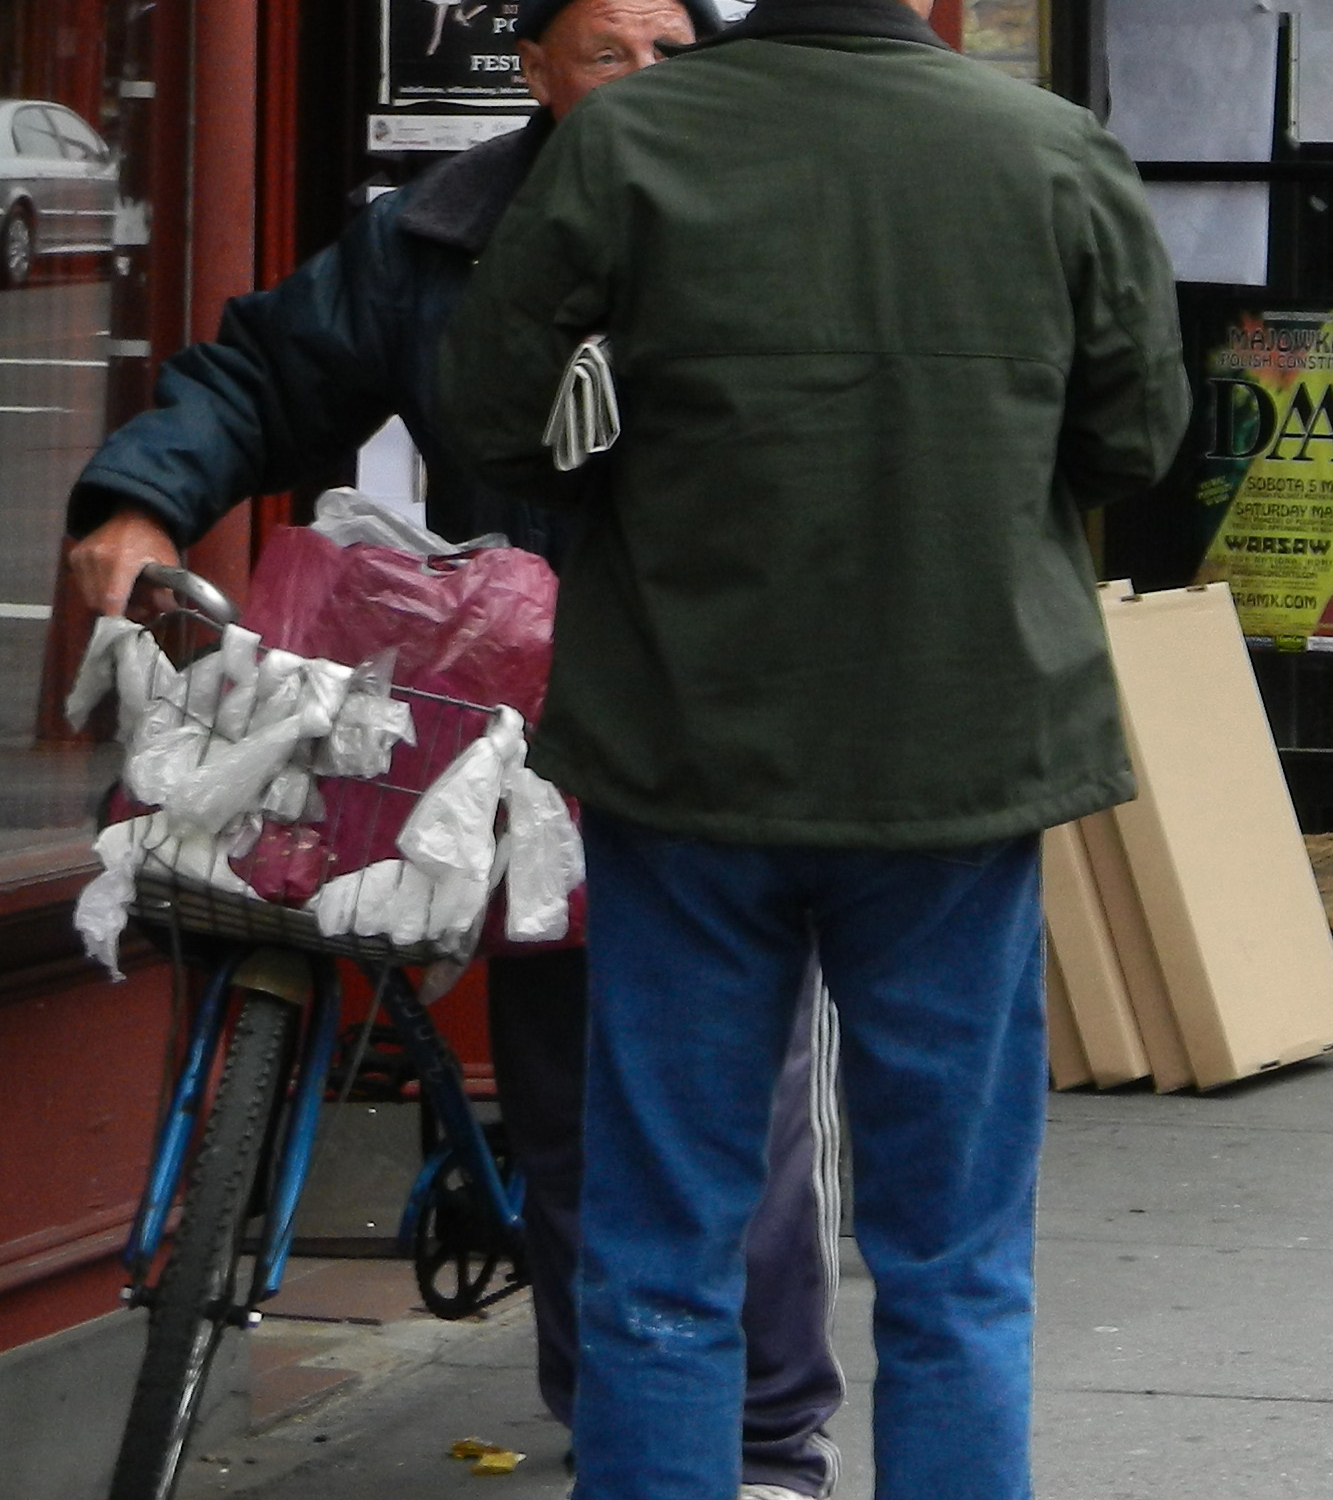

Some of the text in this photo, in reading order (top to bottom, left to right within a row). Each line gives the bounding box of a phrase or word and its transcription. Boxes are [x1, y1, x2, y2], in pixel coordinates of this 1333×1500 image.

[1247, 476, 1304, 494] SOBOTA
[1235, 501, 1308, 519] SATURDAY
[1224, 534, 1332, 555] WARSAW
